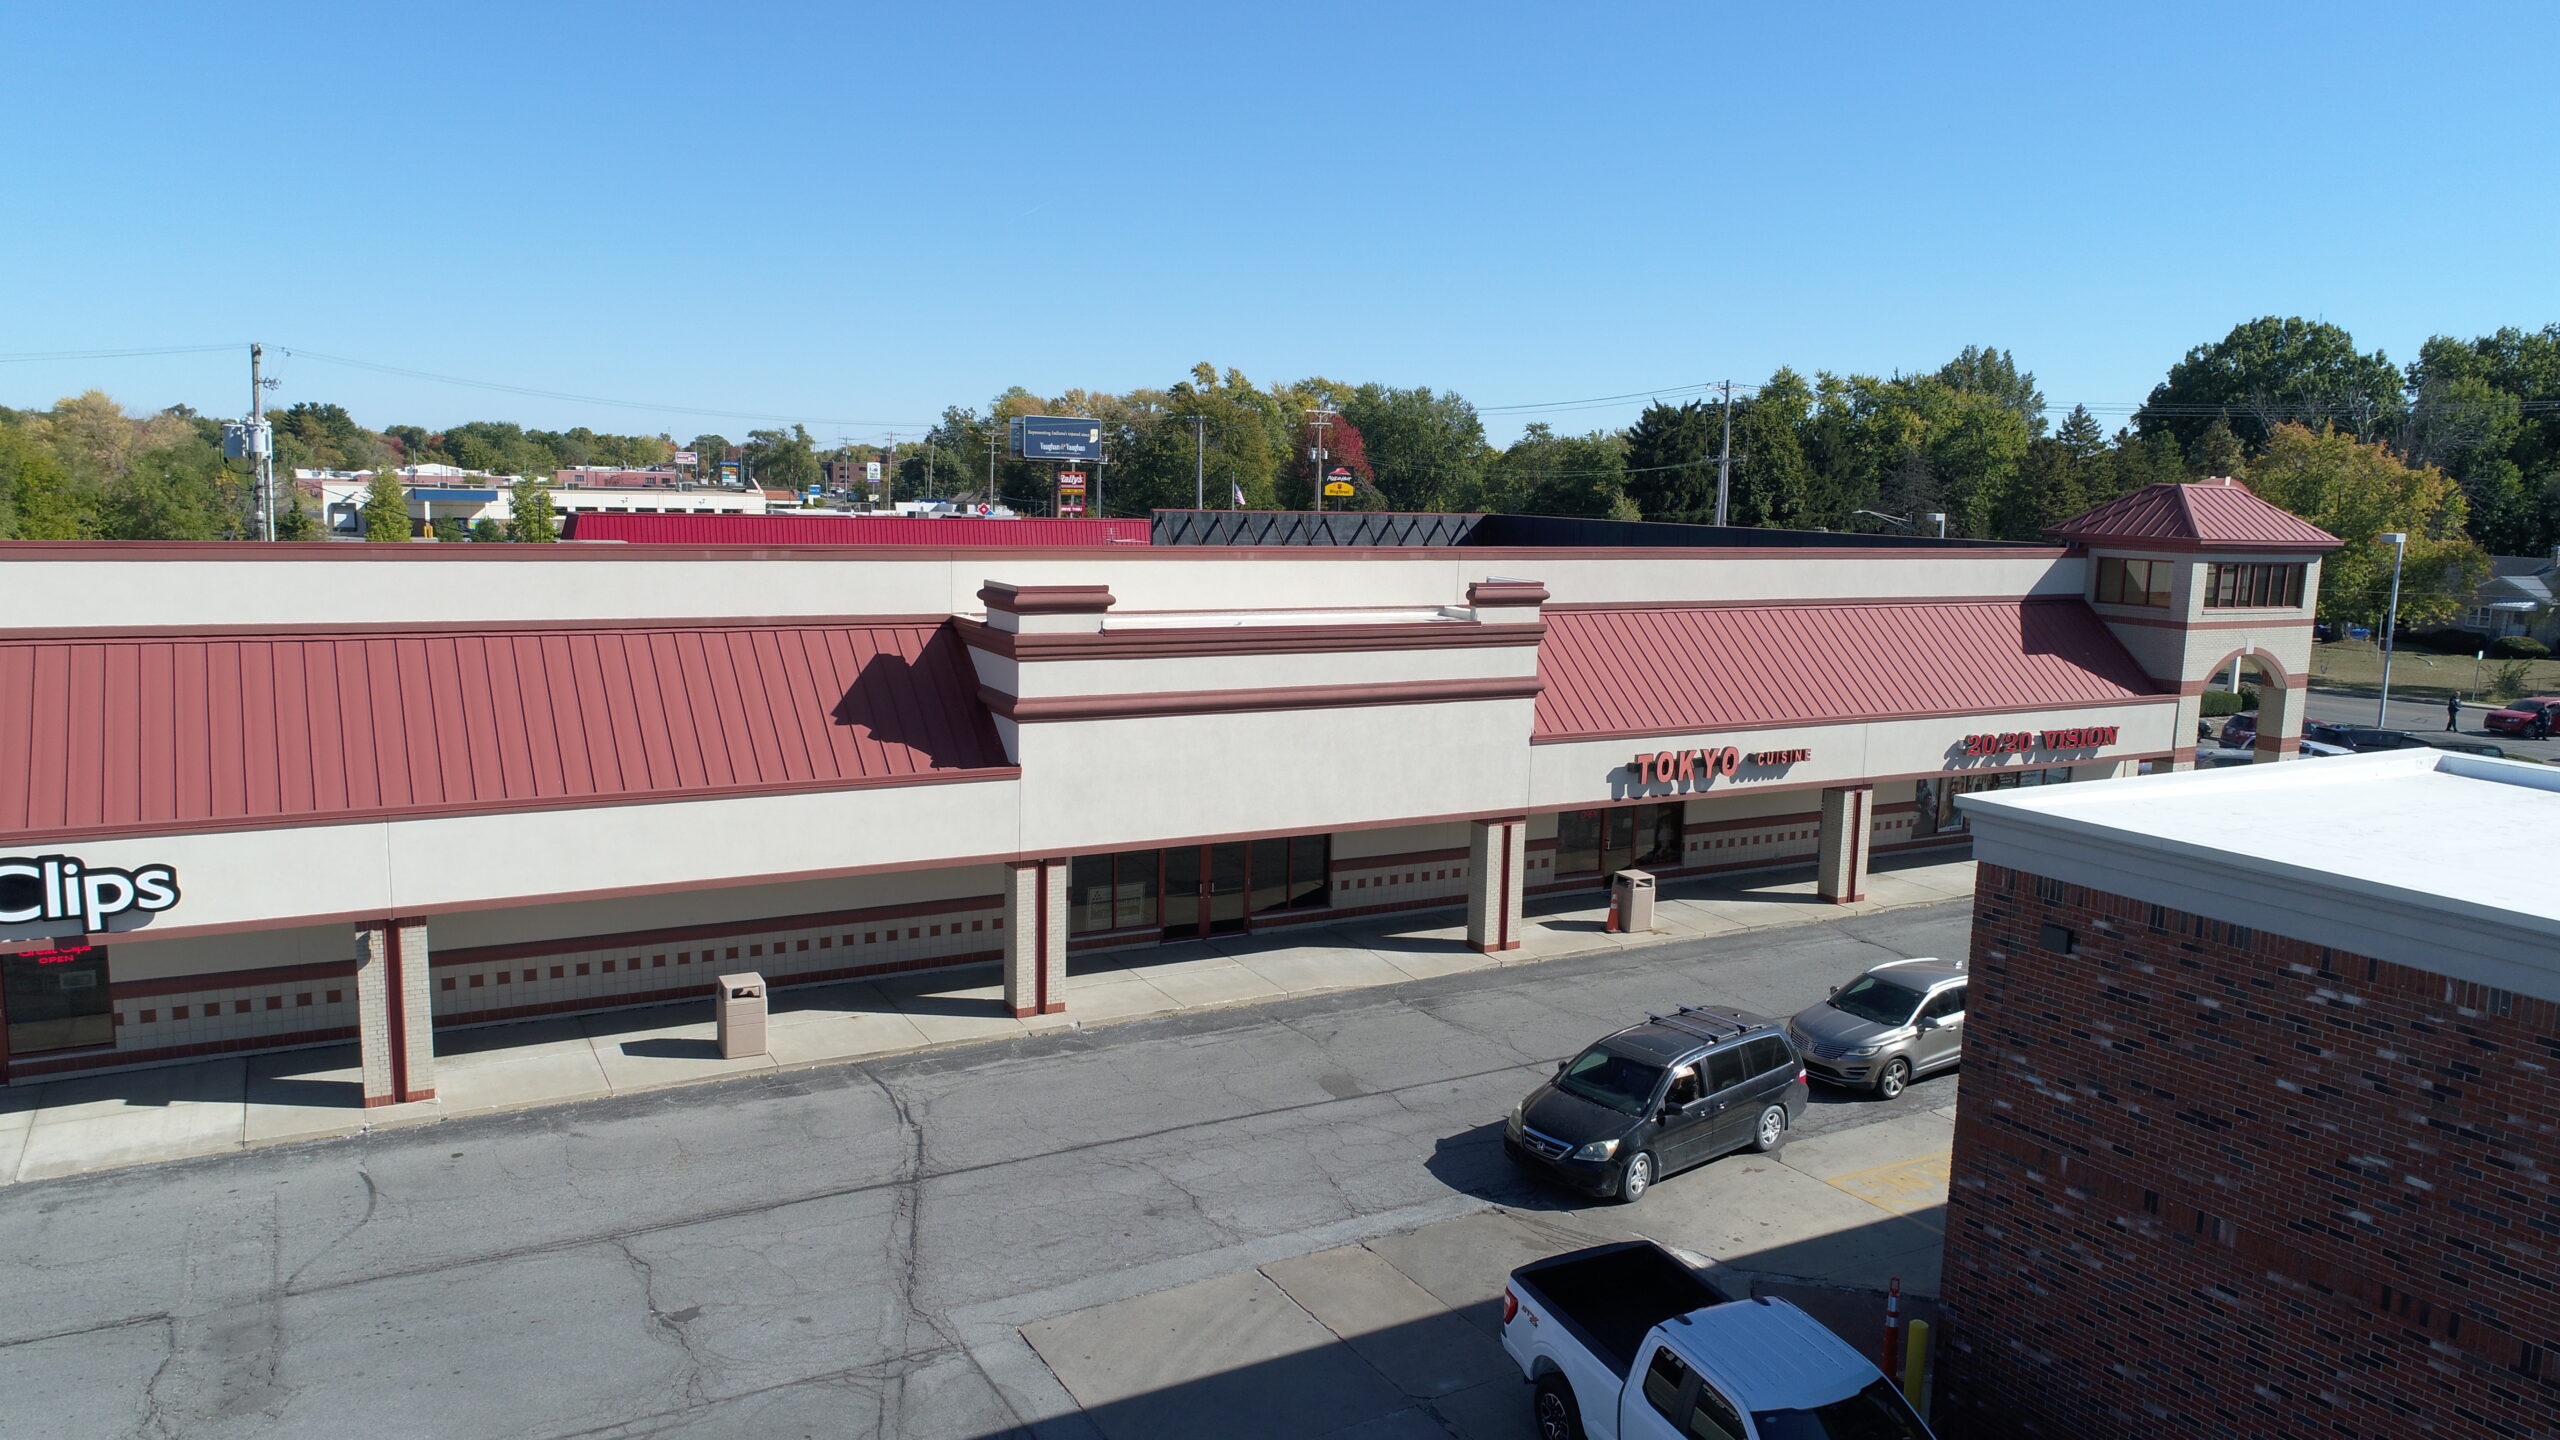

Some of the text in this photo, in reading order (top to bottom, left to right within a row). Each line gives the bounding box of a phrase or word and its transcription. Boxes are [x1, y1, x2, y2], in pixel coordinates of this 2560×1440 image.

[1061, 475, 1083, 484] Rally's
[1966, 726, 2120, 756] 20/20 VISION
[1635, 746, 1812, 785] TOKYO CUISINE
[0, 860, 175, 932] Clips
[38, 955, 75, 965] OPEN
